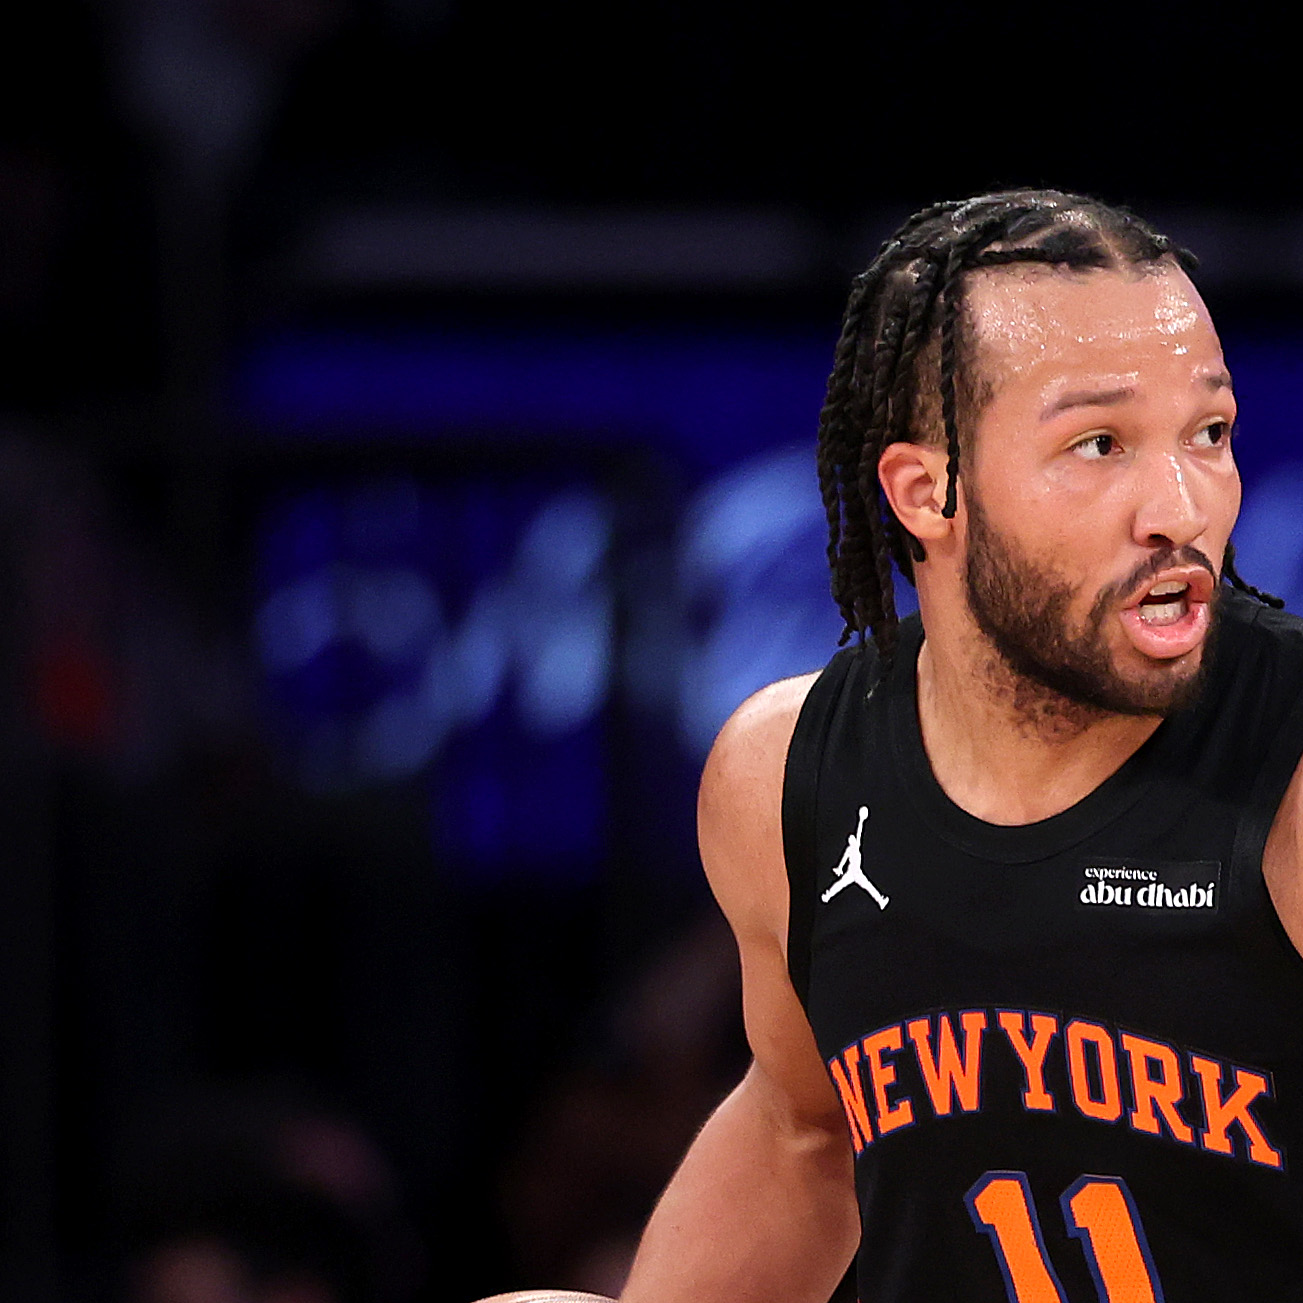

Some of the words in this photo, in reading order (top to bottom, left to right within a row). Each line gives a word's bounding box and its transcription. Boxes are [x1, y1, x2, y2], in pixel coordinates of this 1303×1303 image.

[1084, 866, 1158, 881] experience
[1080, 880, 1132, 906] abu
[828, 1008, 988, 1158] NEW
[996, 1008, 1285, 1172] YORK
